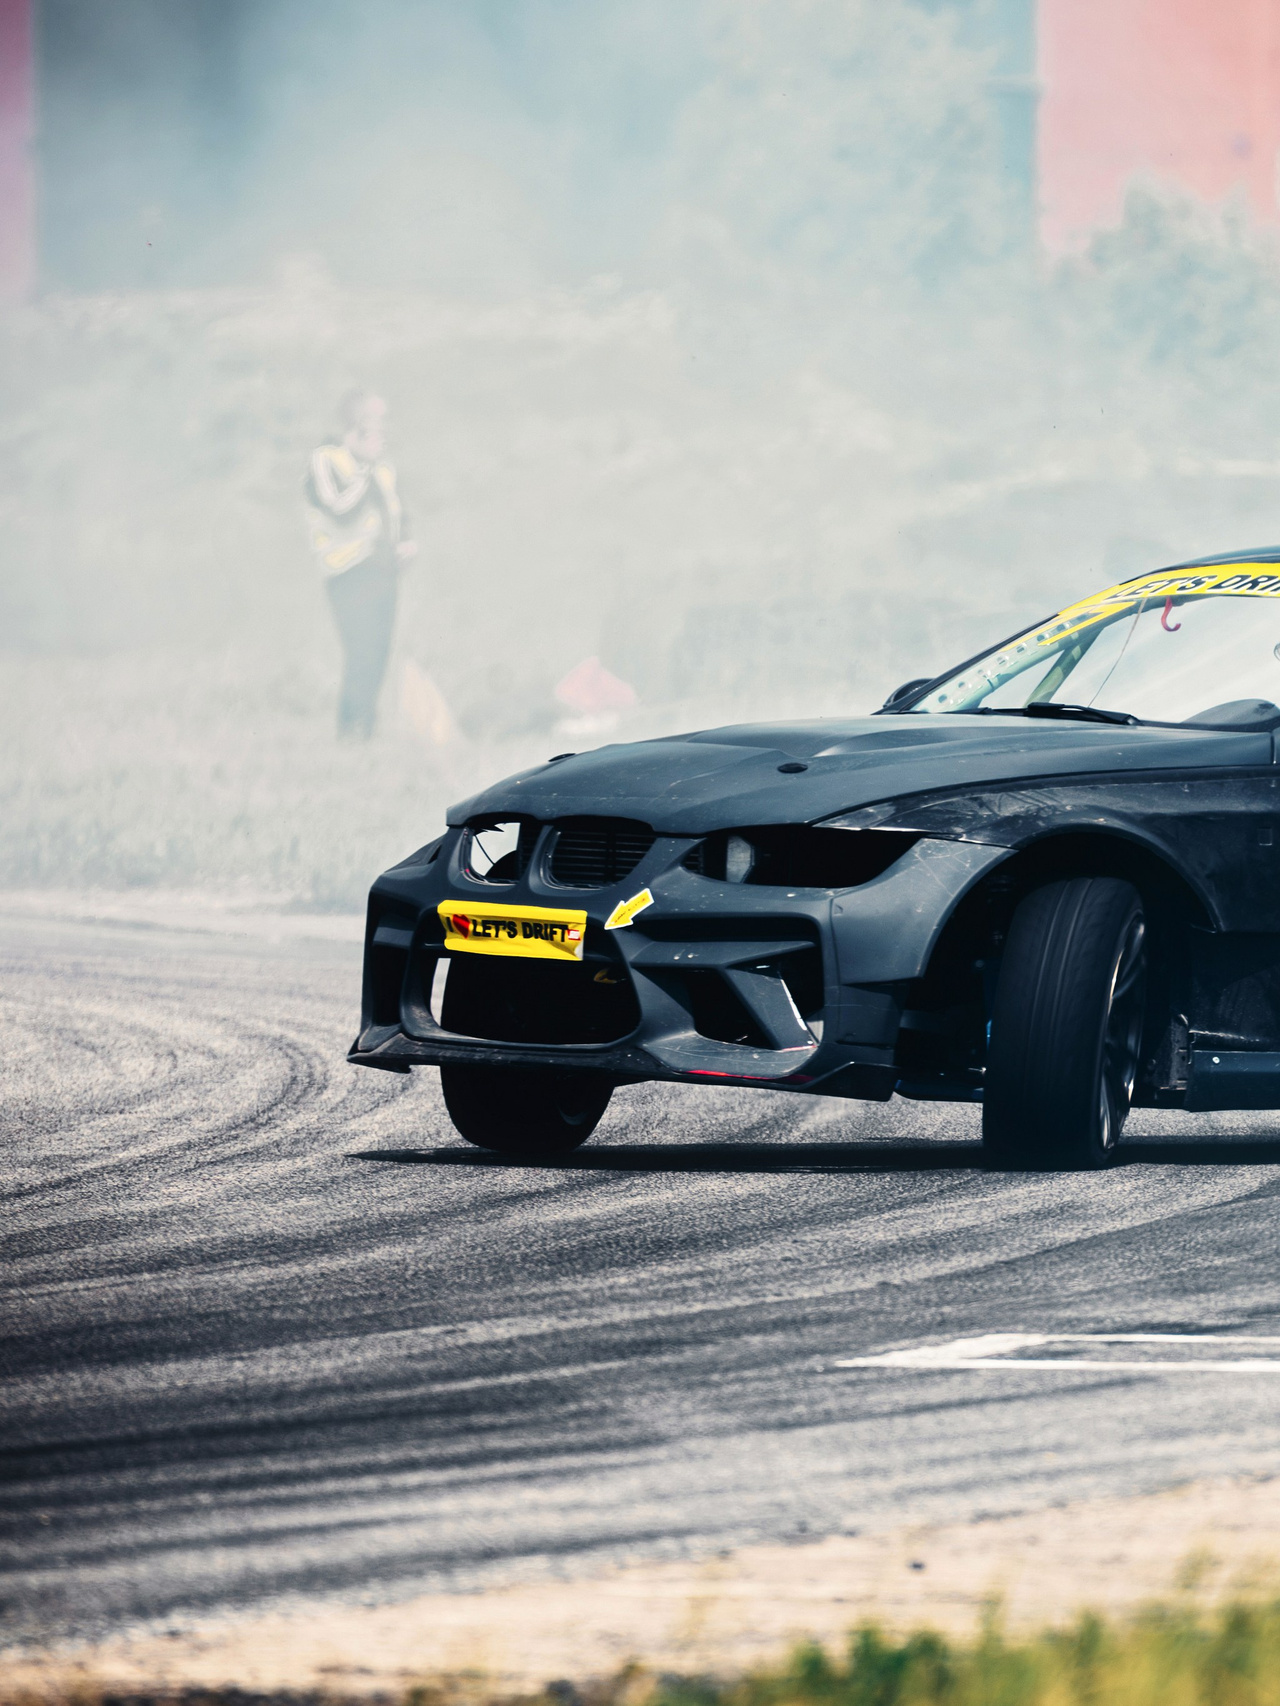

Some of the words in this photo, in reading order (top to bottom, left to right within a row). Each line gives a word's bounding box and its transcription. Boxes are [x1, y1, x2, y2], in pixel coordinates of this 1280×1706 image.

[1102, 575, 1217, 599] LET'S
[472, 919, 518, 938] LET'S
[521, 922, 569, 942] DRIFT
